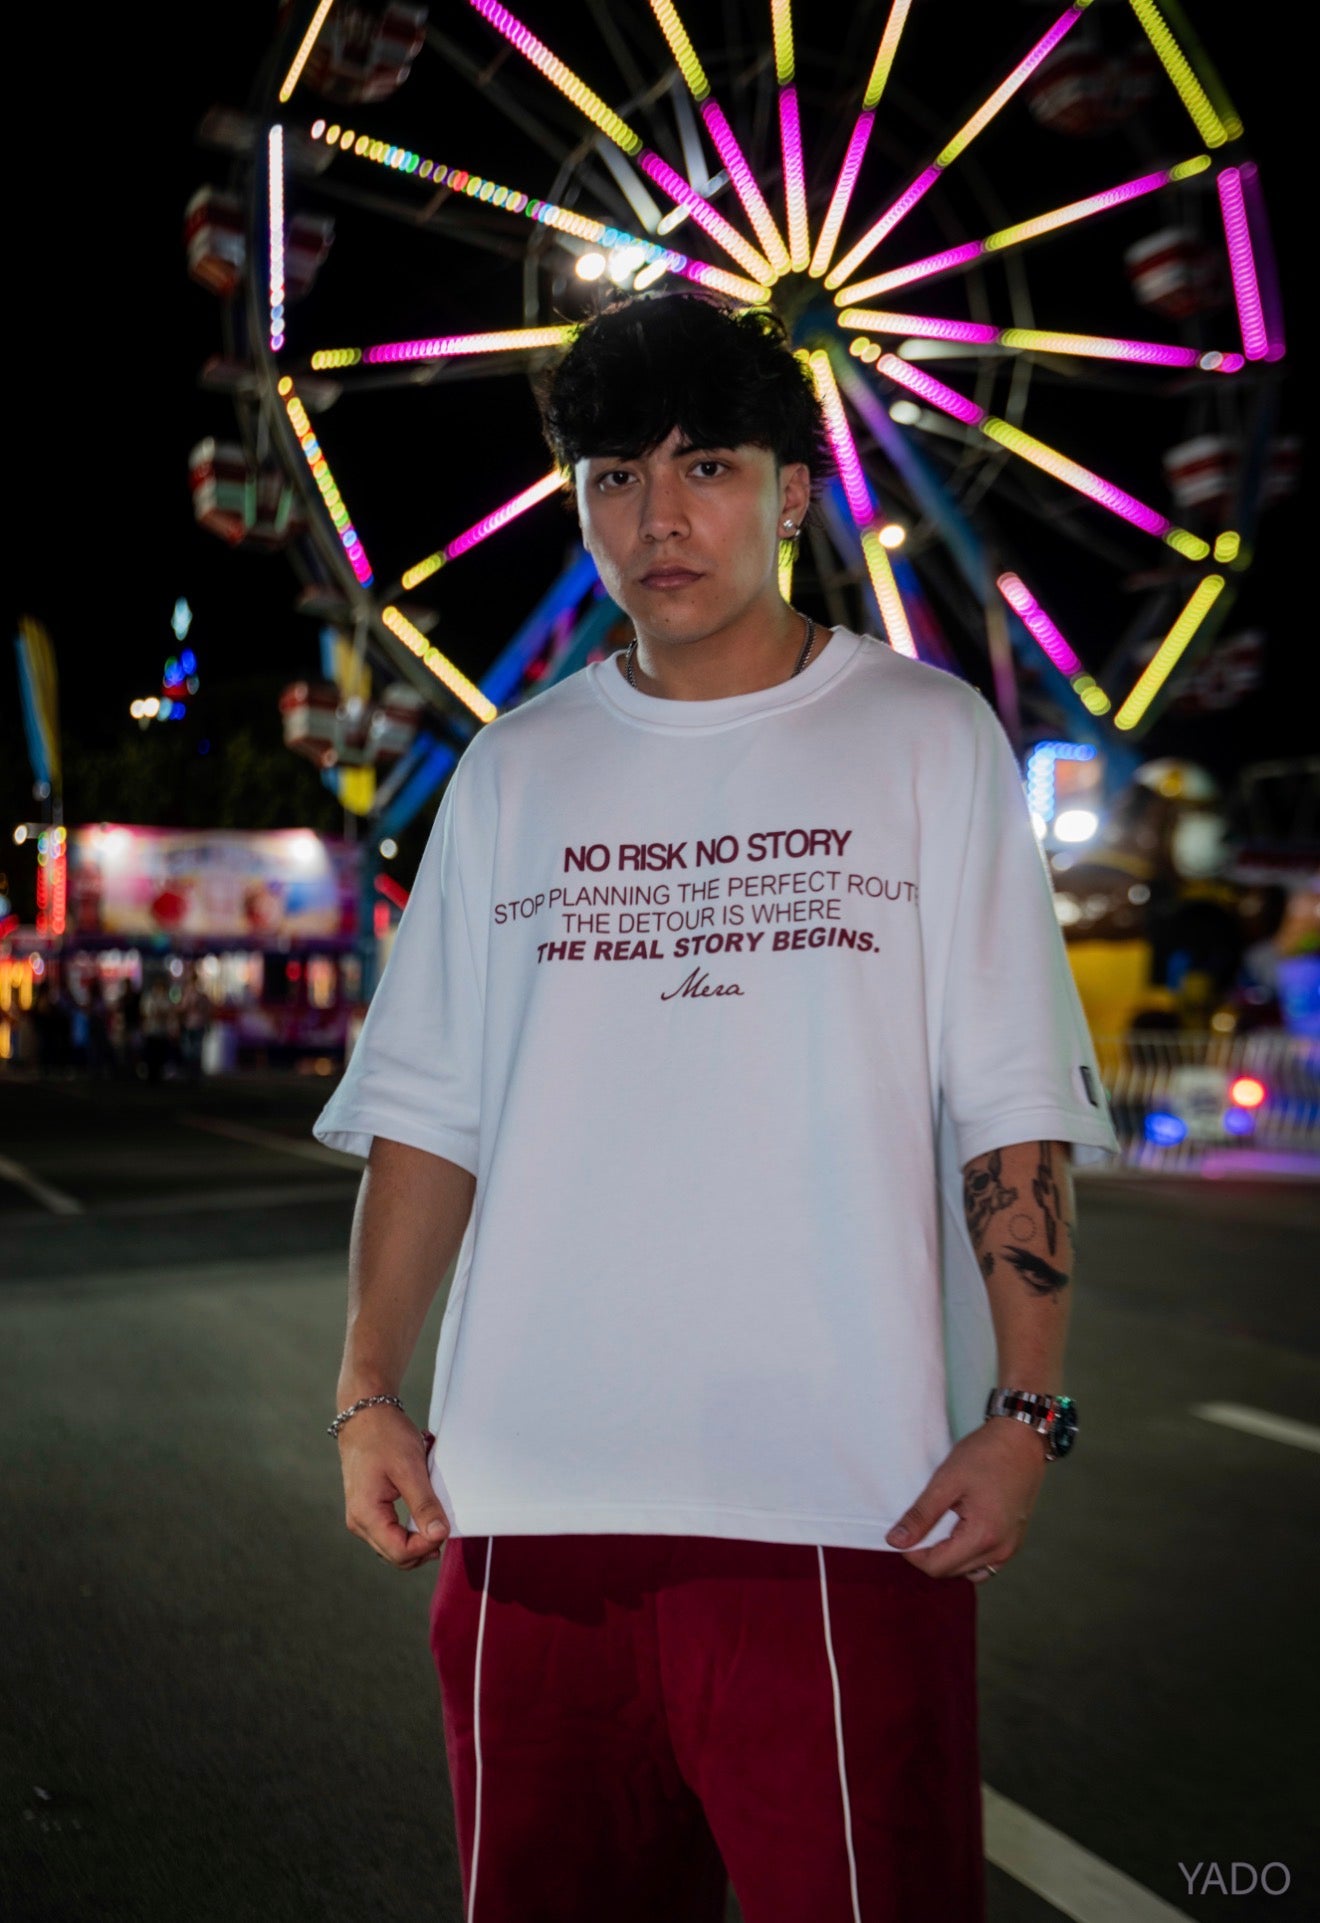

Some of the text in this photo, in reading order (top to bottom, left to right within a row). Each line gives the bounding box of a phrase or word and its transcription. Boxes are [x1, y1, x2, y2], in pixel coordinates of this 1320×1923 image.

[563, 829, 852, 872] NO RISK NO STORY
[494, 893, 545, 925] STOP
[548, 884, 671, 908] PLANNING
[677, 879, 720, 903] THE
[728, 871, 841, 897] PERFECT
[562, 899, 841, 934] THE DETOUR IS WHERE
[537, 926, 881, 964] THE REAL STORY BEGINS.
